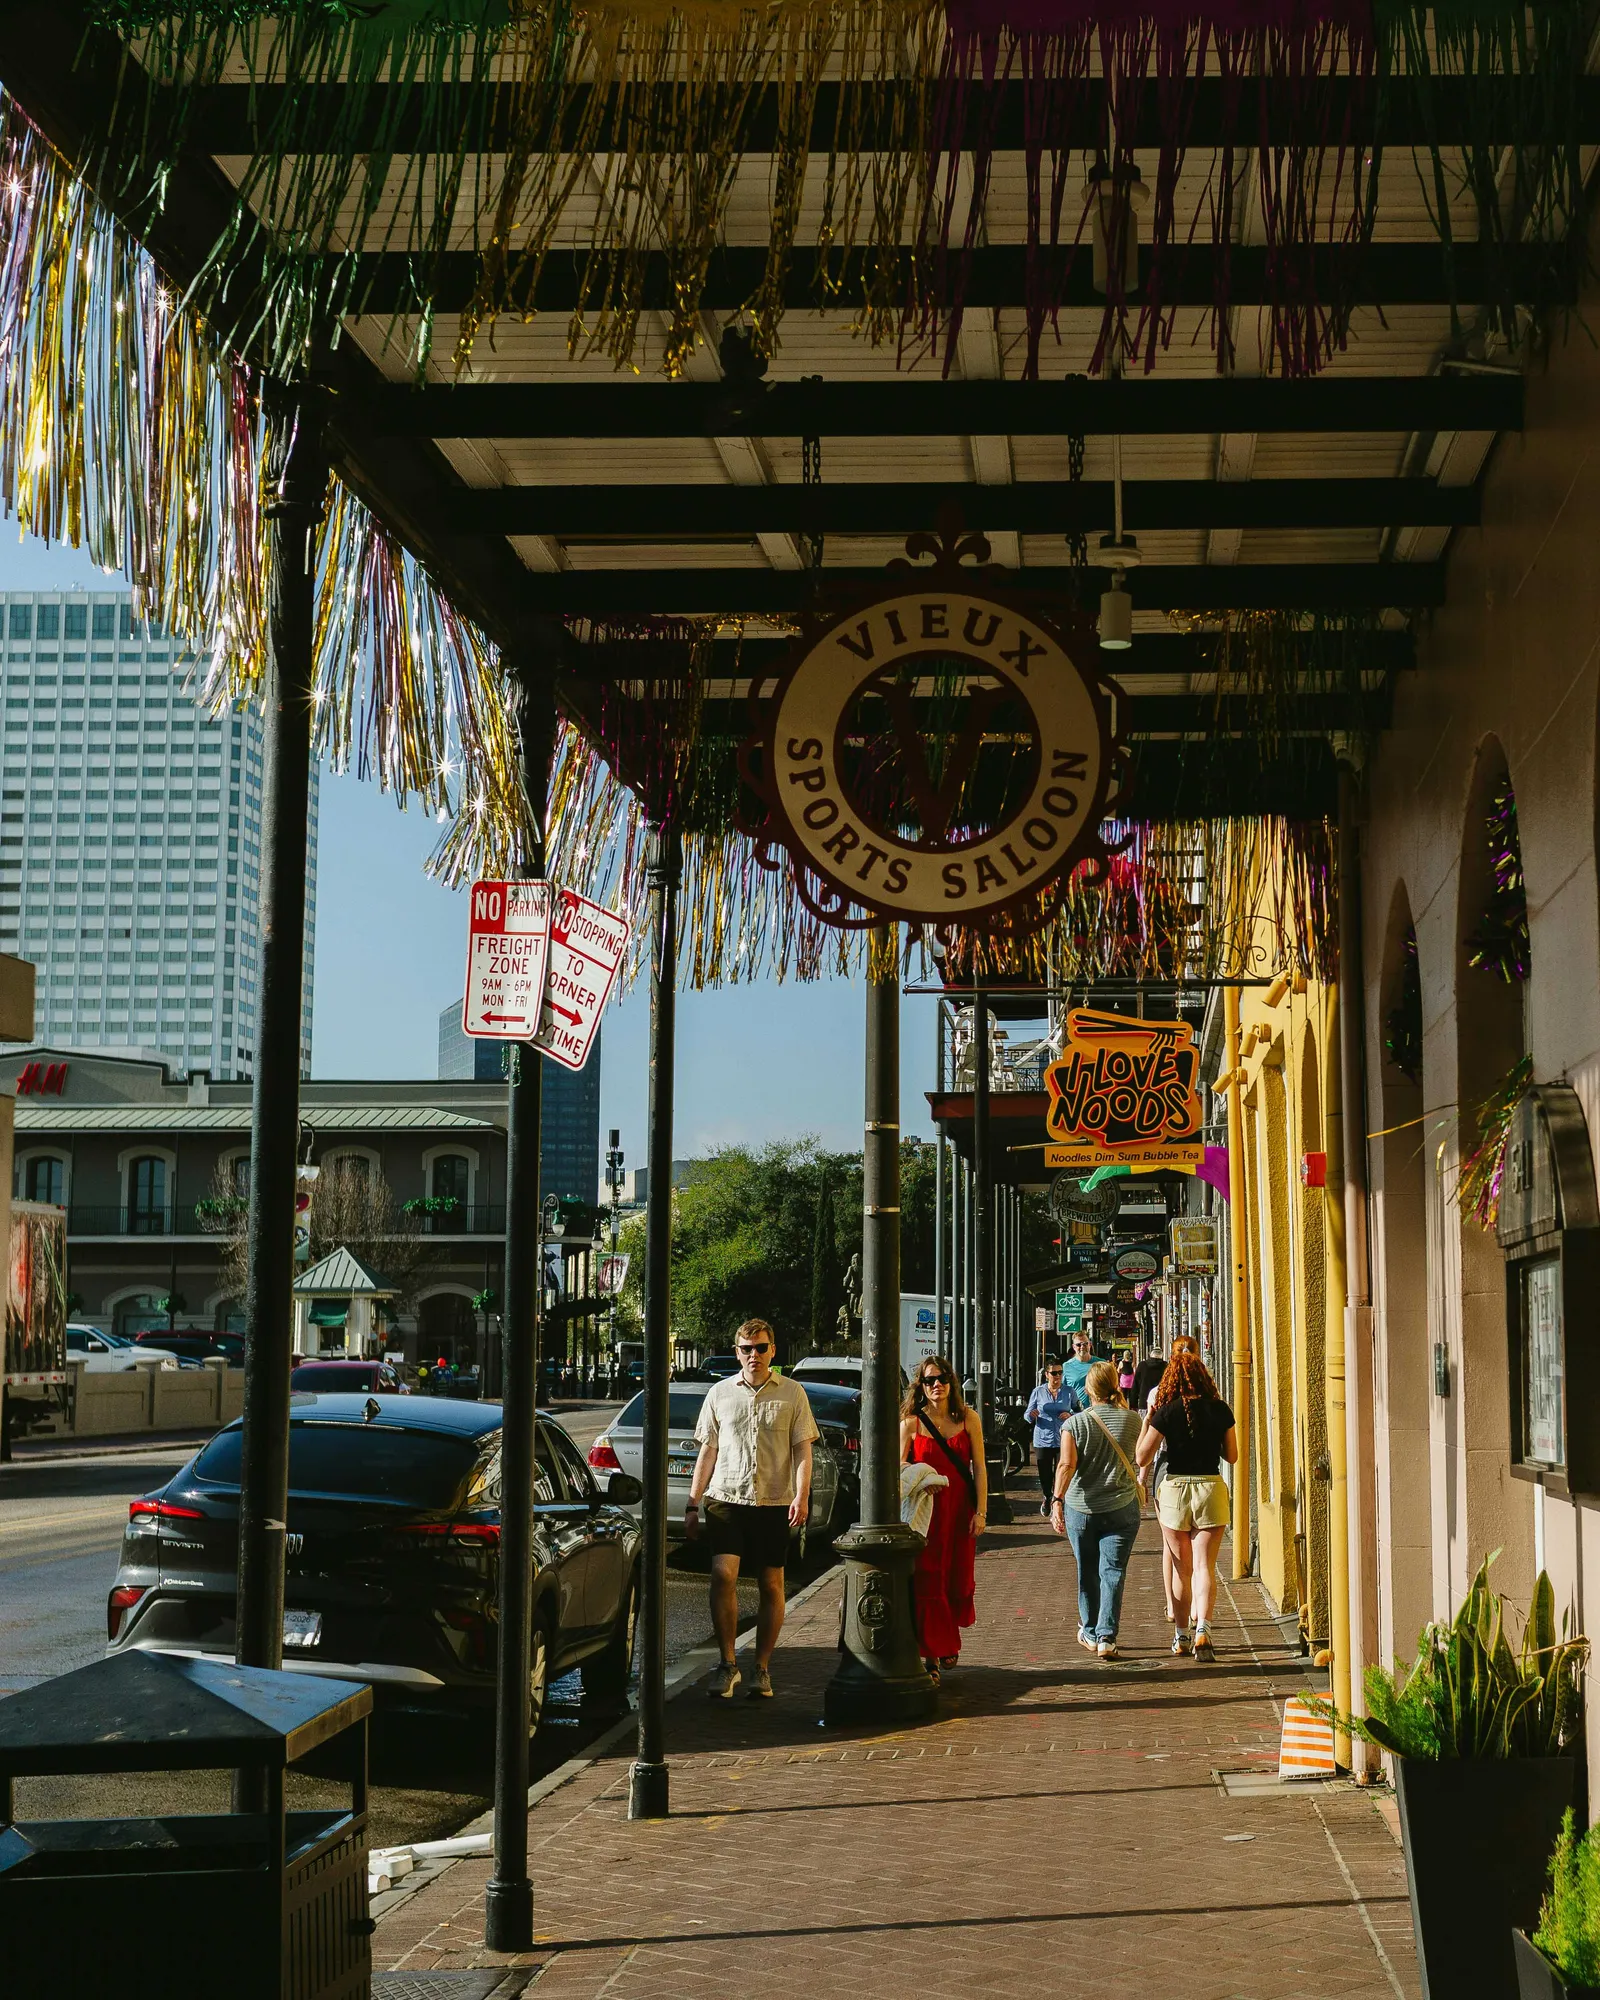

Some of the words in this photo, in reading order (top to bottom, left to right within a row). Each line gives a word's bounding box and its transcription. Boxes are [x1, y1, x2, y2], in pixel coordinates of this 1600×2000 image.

[836, 604, 1048, 678] VIEUX
[786, 737, 913, 895] SPORTS
[942, 750, 1089, 899] SALOON
[475, 891, 501, 921] NO
[507, 900, 546, 918] PARKING
[552, 900, 576, 933] NO
[572, 915, 623, 956] STOPPING
[477, 937, 541, 956] FREIGHT
[489, 957, 529, 975] ZONE
[566, 953, 584, 976] TO
[481, 978, 502, 991] 9AM
[514, 979, 532, 992] 6PM
[482, 994, 504, 1007] MON
[515, 995, 528, 1008] FRI
[548, 970, 597, 1011] ORNER
[1066, 1051, 1081, 1092] I
[1093, 1047, 1179, 1096] LOVE
[1051, 1072, 1192, 1134] NOODS
[1051, 1153, 1091, 1163] Noodles
[1095, 1152, 1114, 1162] Dim
[1117, 1152, 1140, 1161] Sum
[1143, 1151, 1178, 1161] Bubble
[1182, 1150, 1199, 1160] Tea
